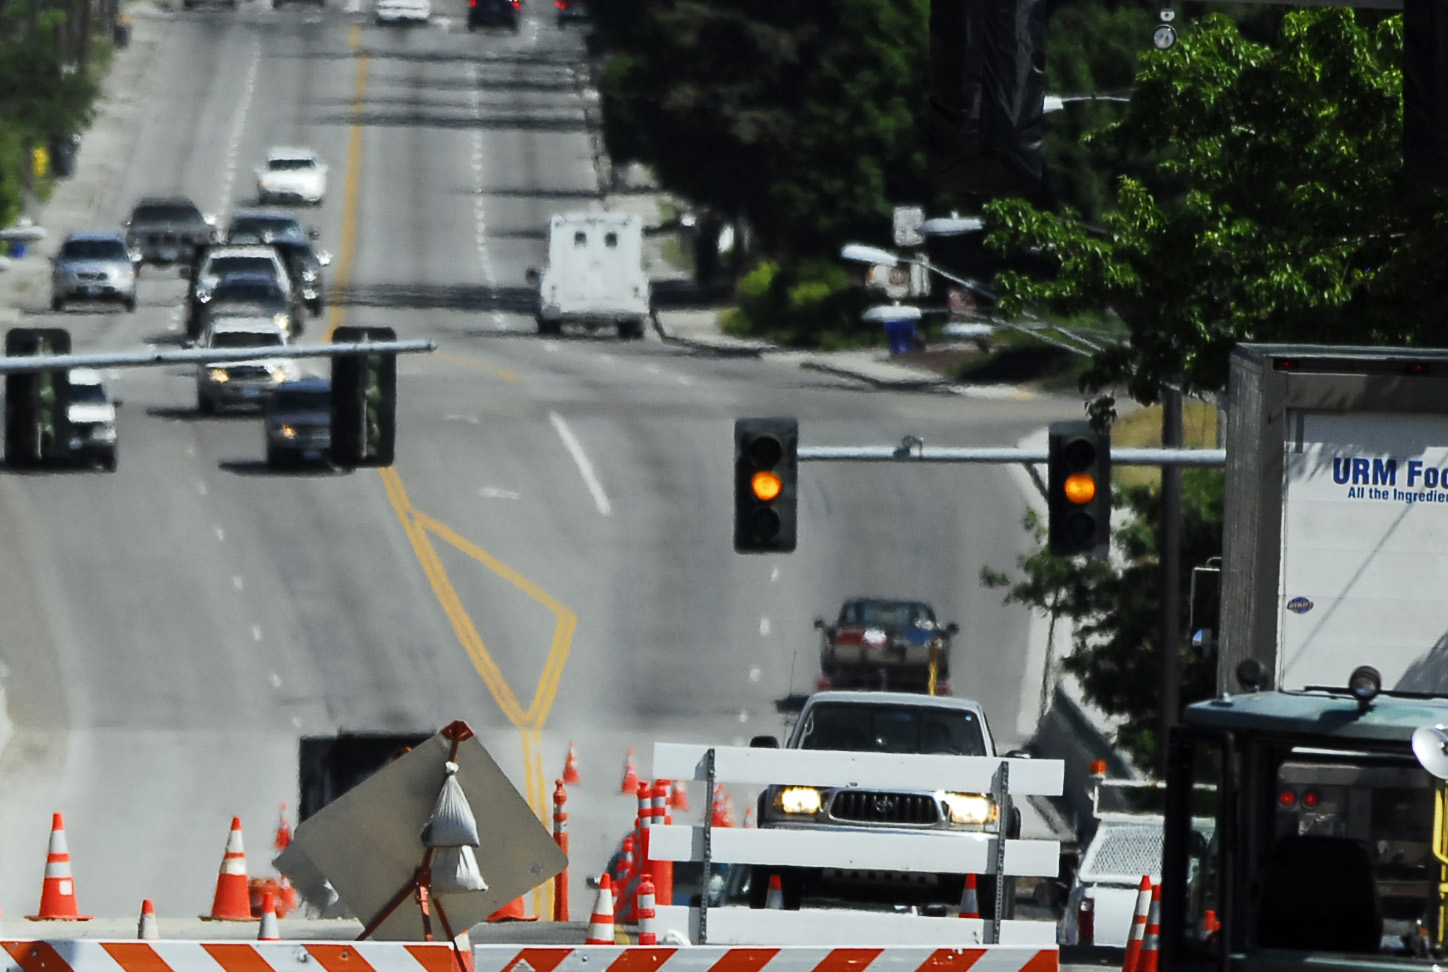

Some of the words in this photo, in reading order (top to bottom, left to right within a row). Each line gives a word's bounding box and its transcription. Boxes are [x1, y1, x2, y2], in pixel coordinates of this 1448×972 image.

[1333, 457, 1396, 486] URM
[1348, 486, 1364, 499] All
[1369, 487, 1389, 500] the
[1393, 488, 1448, 504] Ingredie
